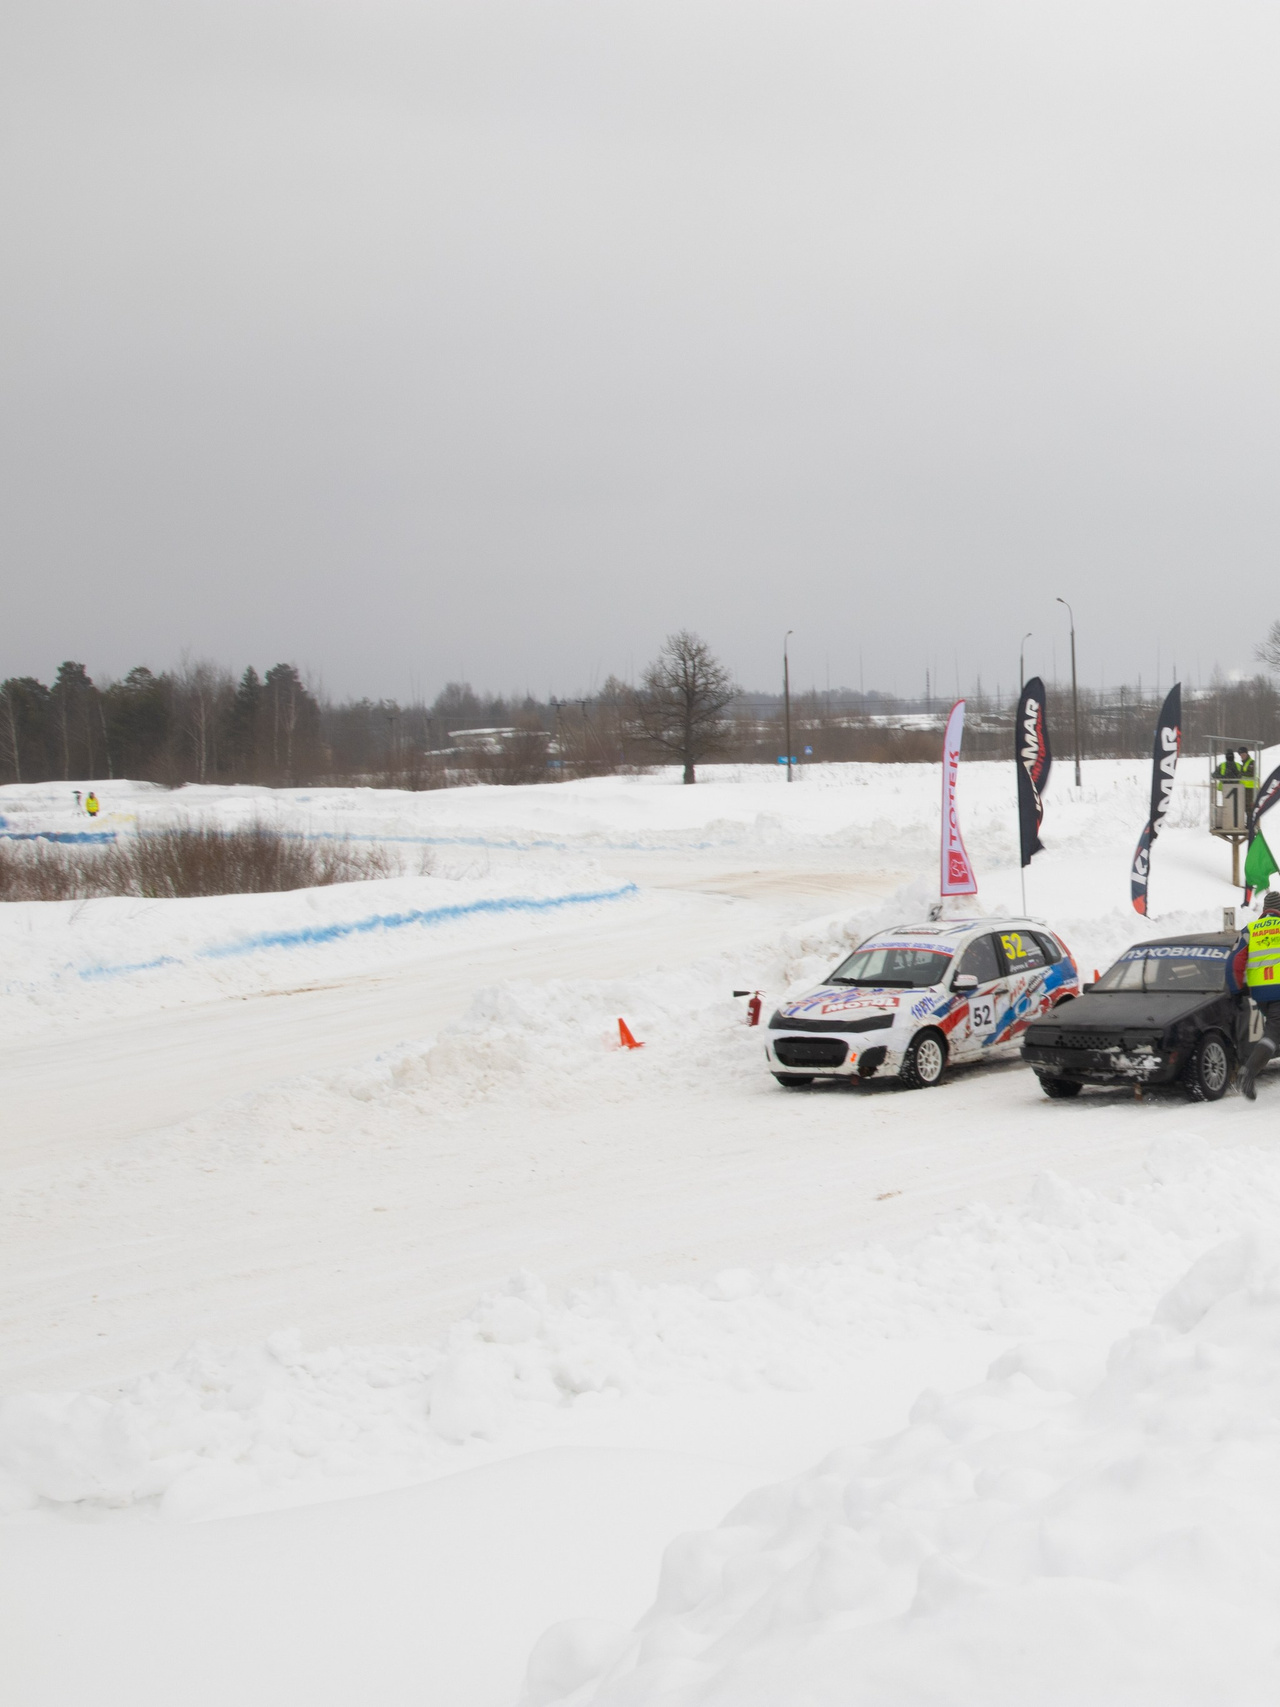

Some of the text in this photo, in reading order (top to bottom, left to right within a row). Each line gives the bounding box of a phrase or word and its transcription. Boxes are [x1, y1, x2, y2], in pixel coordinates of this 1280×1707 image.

[1220, 787, 1239, 829] 1
[1001, 933, 1027, 960] 52
[1121, 946, 1231, 960] ЛУХОВИЦЫ
[825, 997, 897, 1013] MOTUL
[973, 1005, 992, 1027] 52
